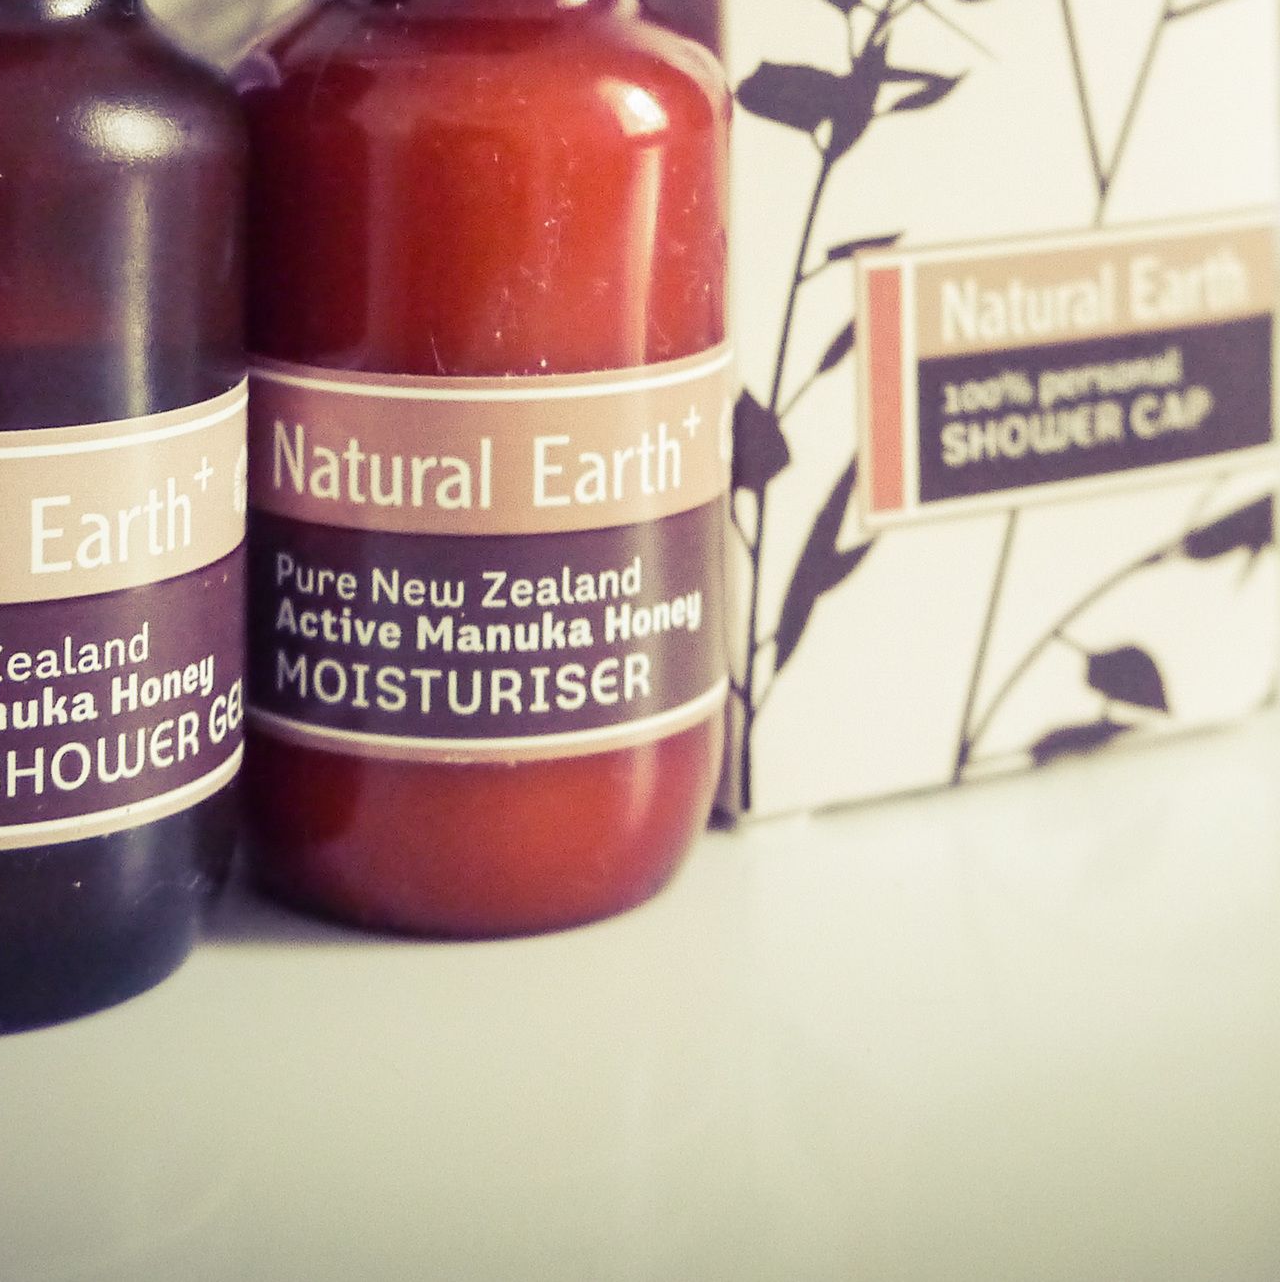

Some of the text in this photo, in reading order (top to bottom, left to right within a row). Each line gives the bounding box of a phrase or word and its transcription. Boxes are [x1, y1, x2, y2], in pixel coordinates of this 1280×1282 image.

[939, 250, 1251, 345] Natural Earth
[942, 369, 1033, 415] 100%
[940, 386, 1214, 468] SHOWER CAP
[272, 419, 493, 510] Natural
[274, 552, 642, 608] Pure New Zealand
[276, 590, 702, 654] Active Manuka Honey
[111, 654, 215, 715] Honey
[275, 648, 652, 716] MOISTURISER
